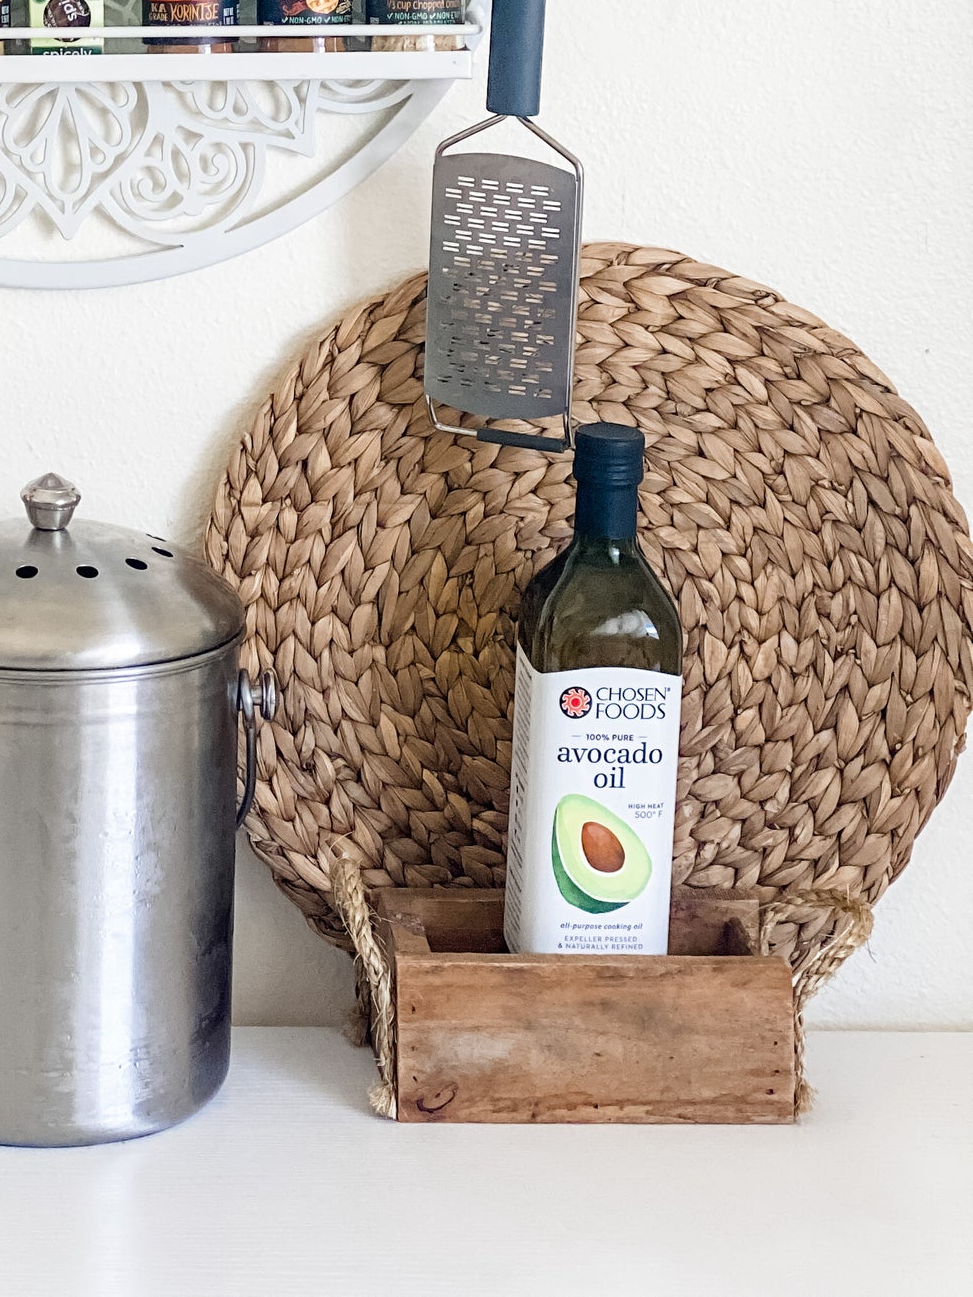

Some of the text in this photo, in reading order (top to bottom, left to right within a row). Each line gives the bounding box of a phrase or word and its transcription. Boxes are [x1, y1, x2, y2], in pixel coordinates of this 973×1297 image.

[151, 3, 167, 12] KA
[397, 0, 445, 12] cup chopped
[149, 12, 168, 21] GRADE
[395, 12, 428, 20] NON-GMO
[596, 687, 667, 702] CHOSEN
[596, 703, 666, 720] FOODS
[586, 734, 634, 742] 100% PURE
[557, 742, 663, 764] avocado
[593, 767, 626, 789] oil
[560, 922, 602, 931] all-purpose
[604, 922, 632, 931] cooking
